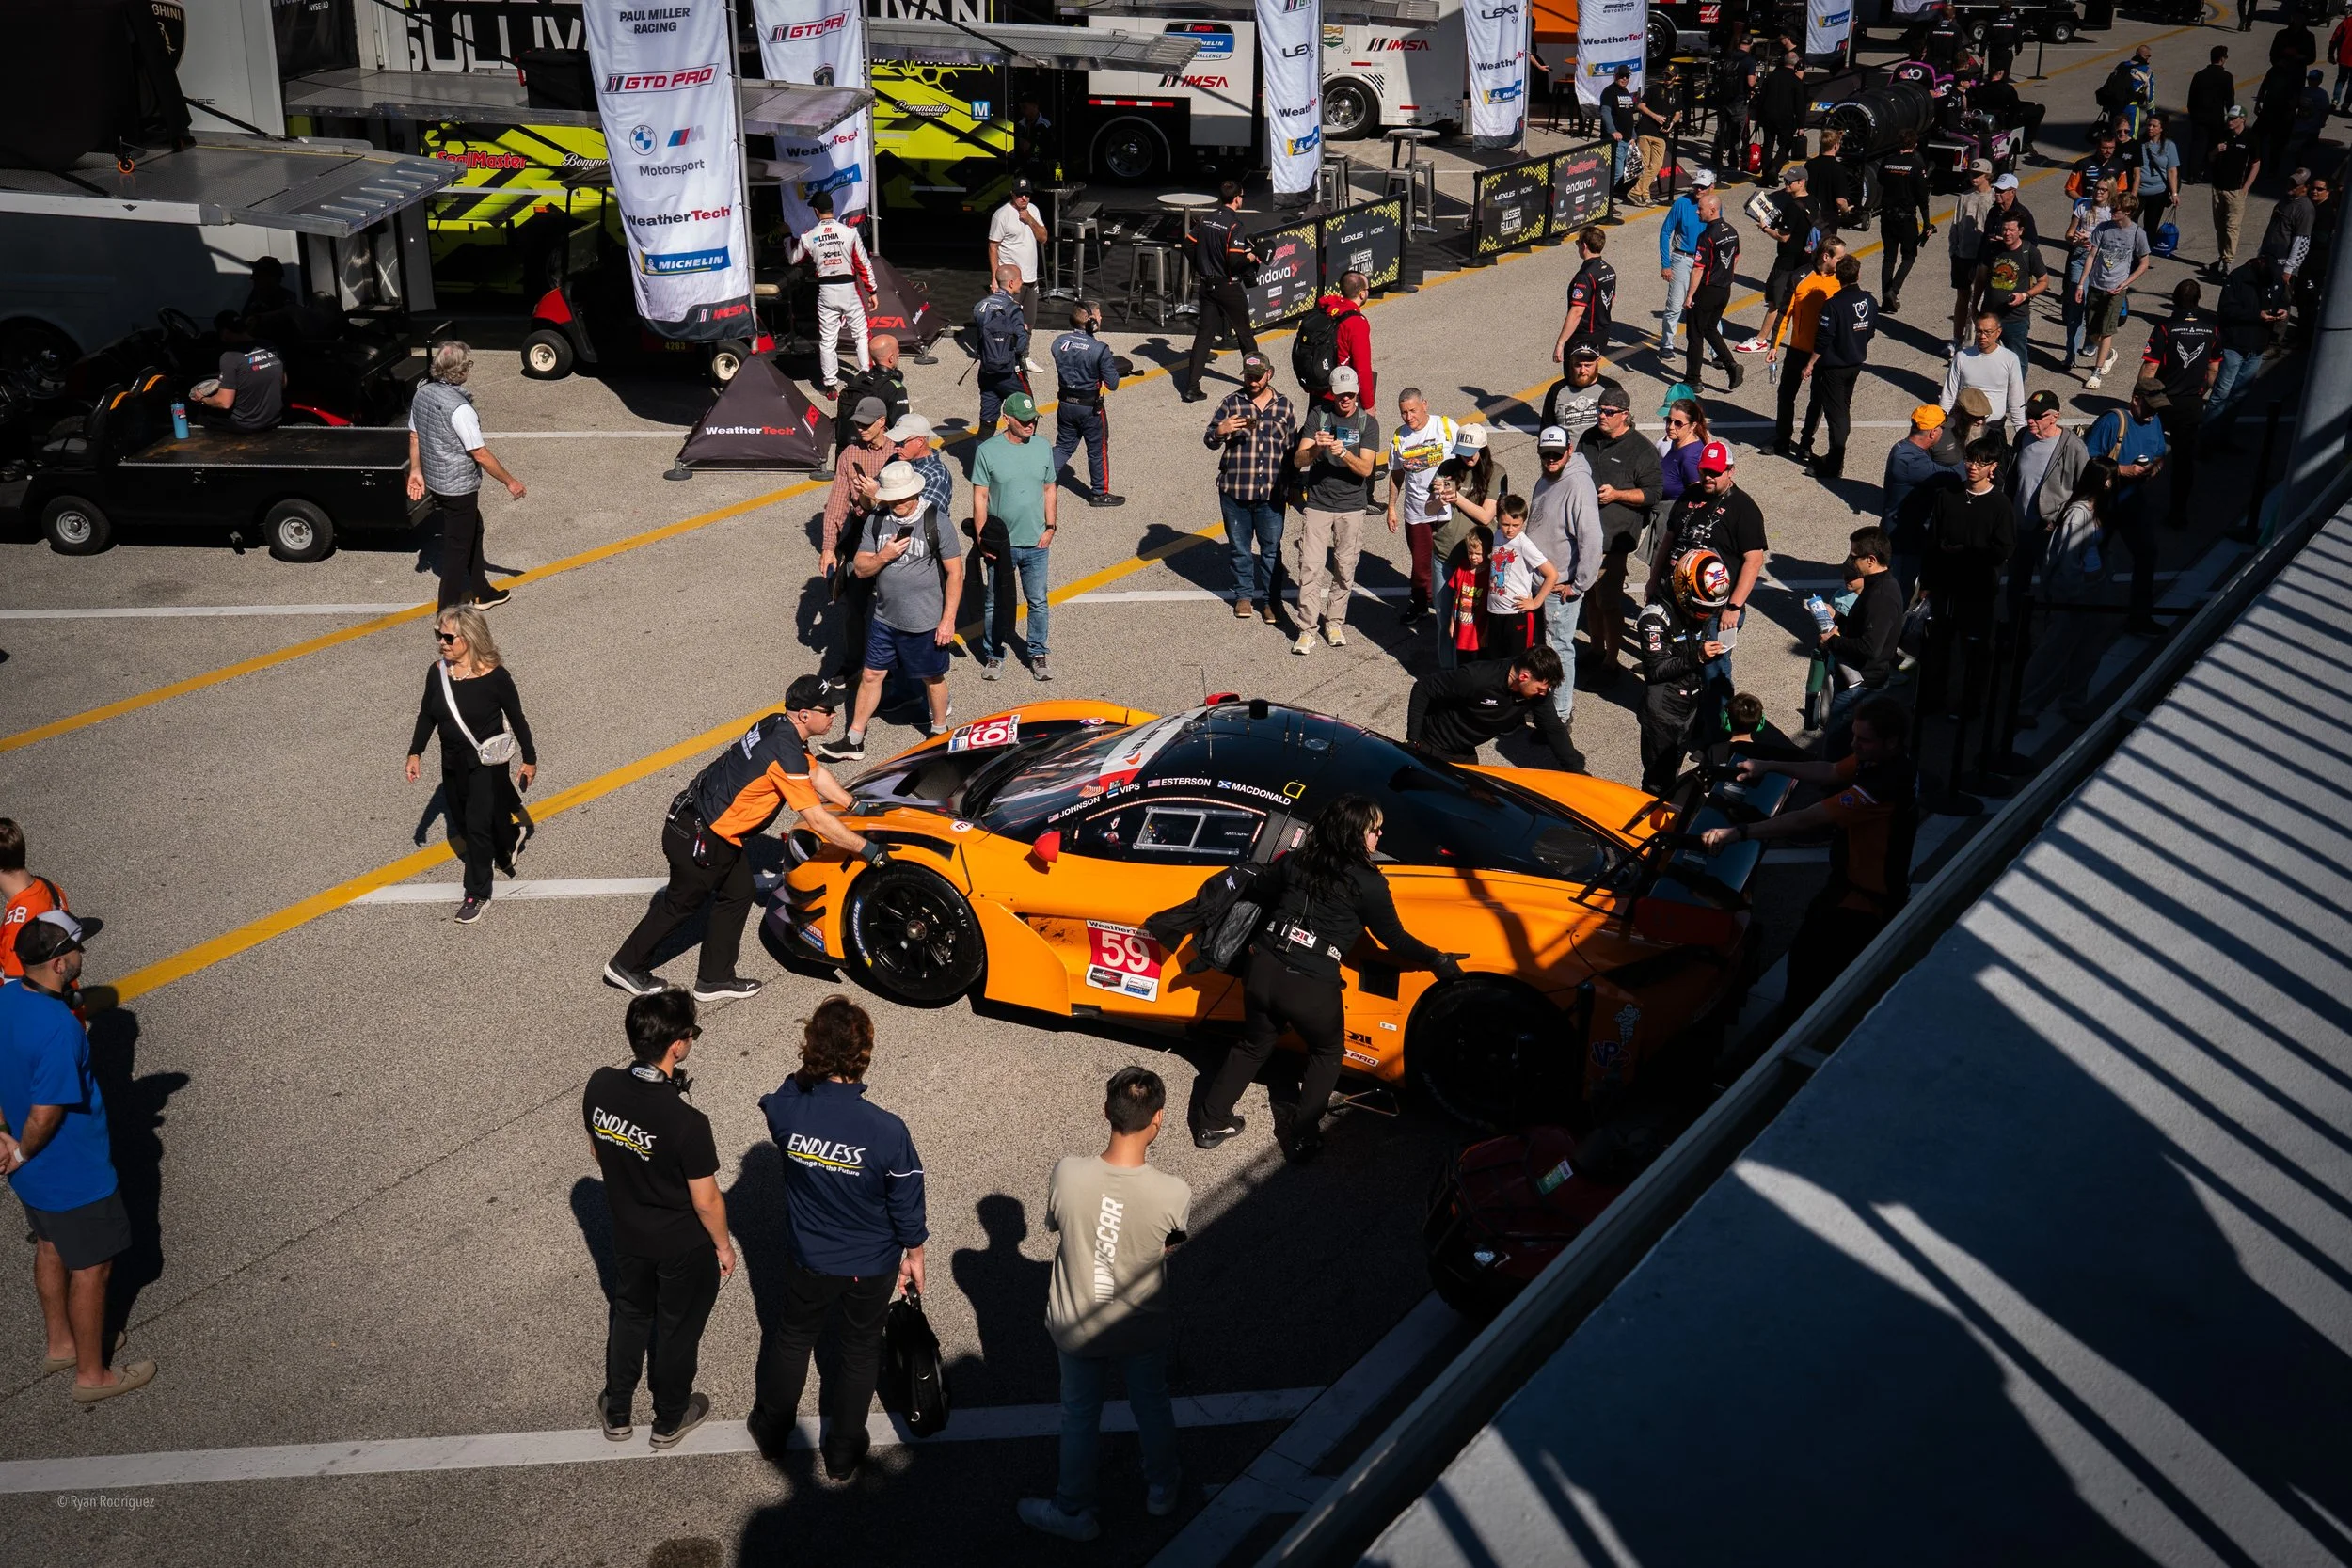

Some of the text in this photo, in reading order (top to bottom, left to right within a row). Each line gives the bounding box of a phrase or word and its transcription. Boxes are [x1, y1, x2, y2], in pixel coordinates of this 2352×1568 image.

[619, 7, 691, 22] PAUL MILLER
[633, 22, 677, 35] RACING
[1192, 24, 1215, 33] IMSA
[1387, 40, 1429, 52] IMSA
[1193, 51, 1223, 60] HALLENGE
[624, 68, 713, 90] GTD PRO
[1181, 75, 1229, 88] IMSA
[639, 159, 706, 177] Motorsport
[1565, 178, 1593, 195] endava
[1494, 189, 1516, 201] LEXUS
[626, 205, 732, 228] WeatherTech
[818, 232, 839, 243] LITHIA
[1341, 230, 1364, 244] LEXUS
[659, 255, 723, 269] MICHELIN
[1257, 266, 1292, 286] ndava
[712, 304, 750, 320] IMSA
[706, 425, 796, 436] WeatherTech
[1120, 783, 1141, 794] VIPS
[1161, 778, 1212, 787] ESTERSON
[1231, 783, 1291, 806] MACDONALD
[1059, 796, 1101, 818] JOHNSON
[5, 906, 27, 926] 58
[851, 900, 865, 950] MICHELIN
[1101, 931, 1151, 973] 59
[1350, 1053, 1375, 1065] PRO
[592, 1106, 658, 1150] ENDLESS
[787, 1132, 866, 1165] ENDLESS
[825, 1164, 838, 1173] the
[837, 1166, 861, 1177] Future
[1094, 1196, 1124, 1283] NASCAR
